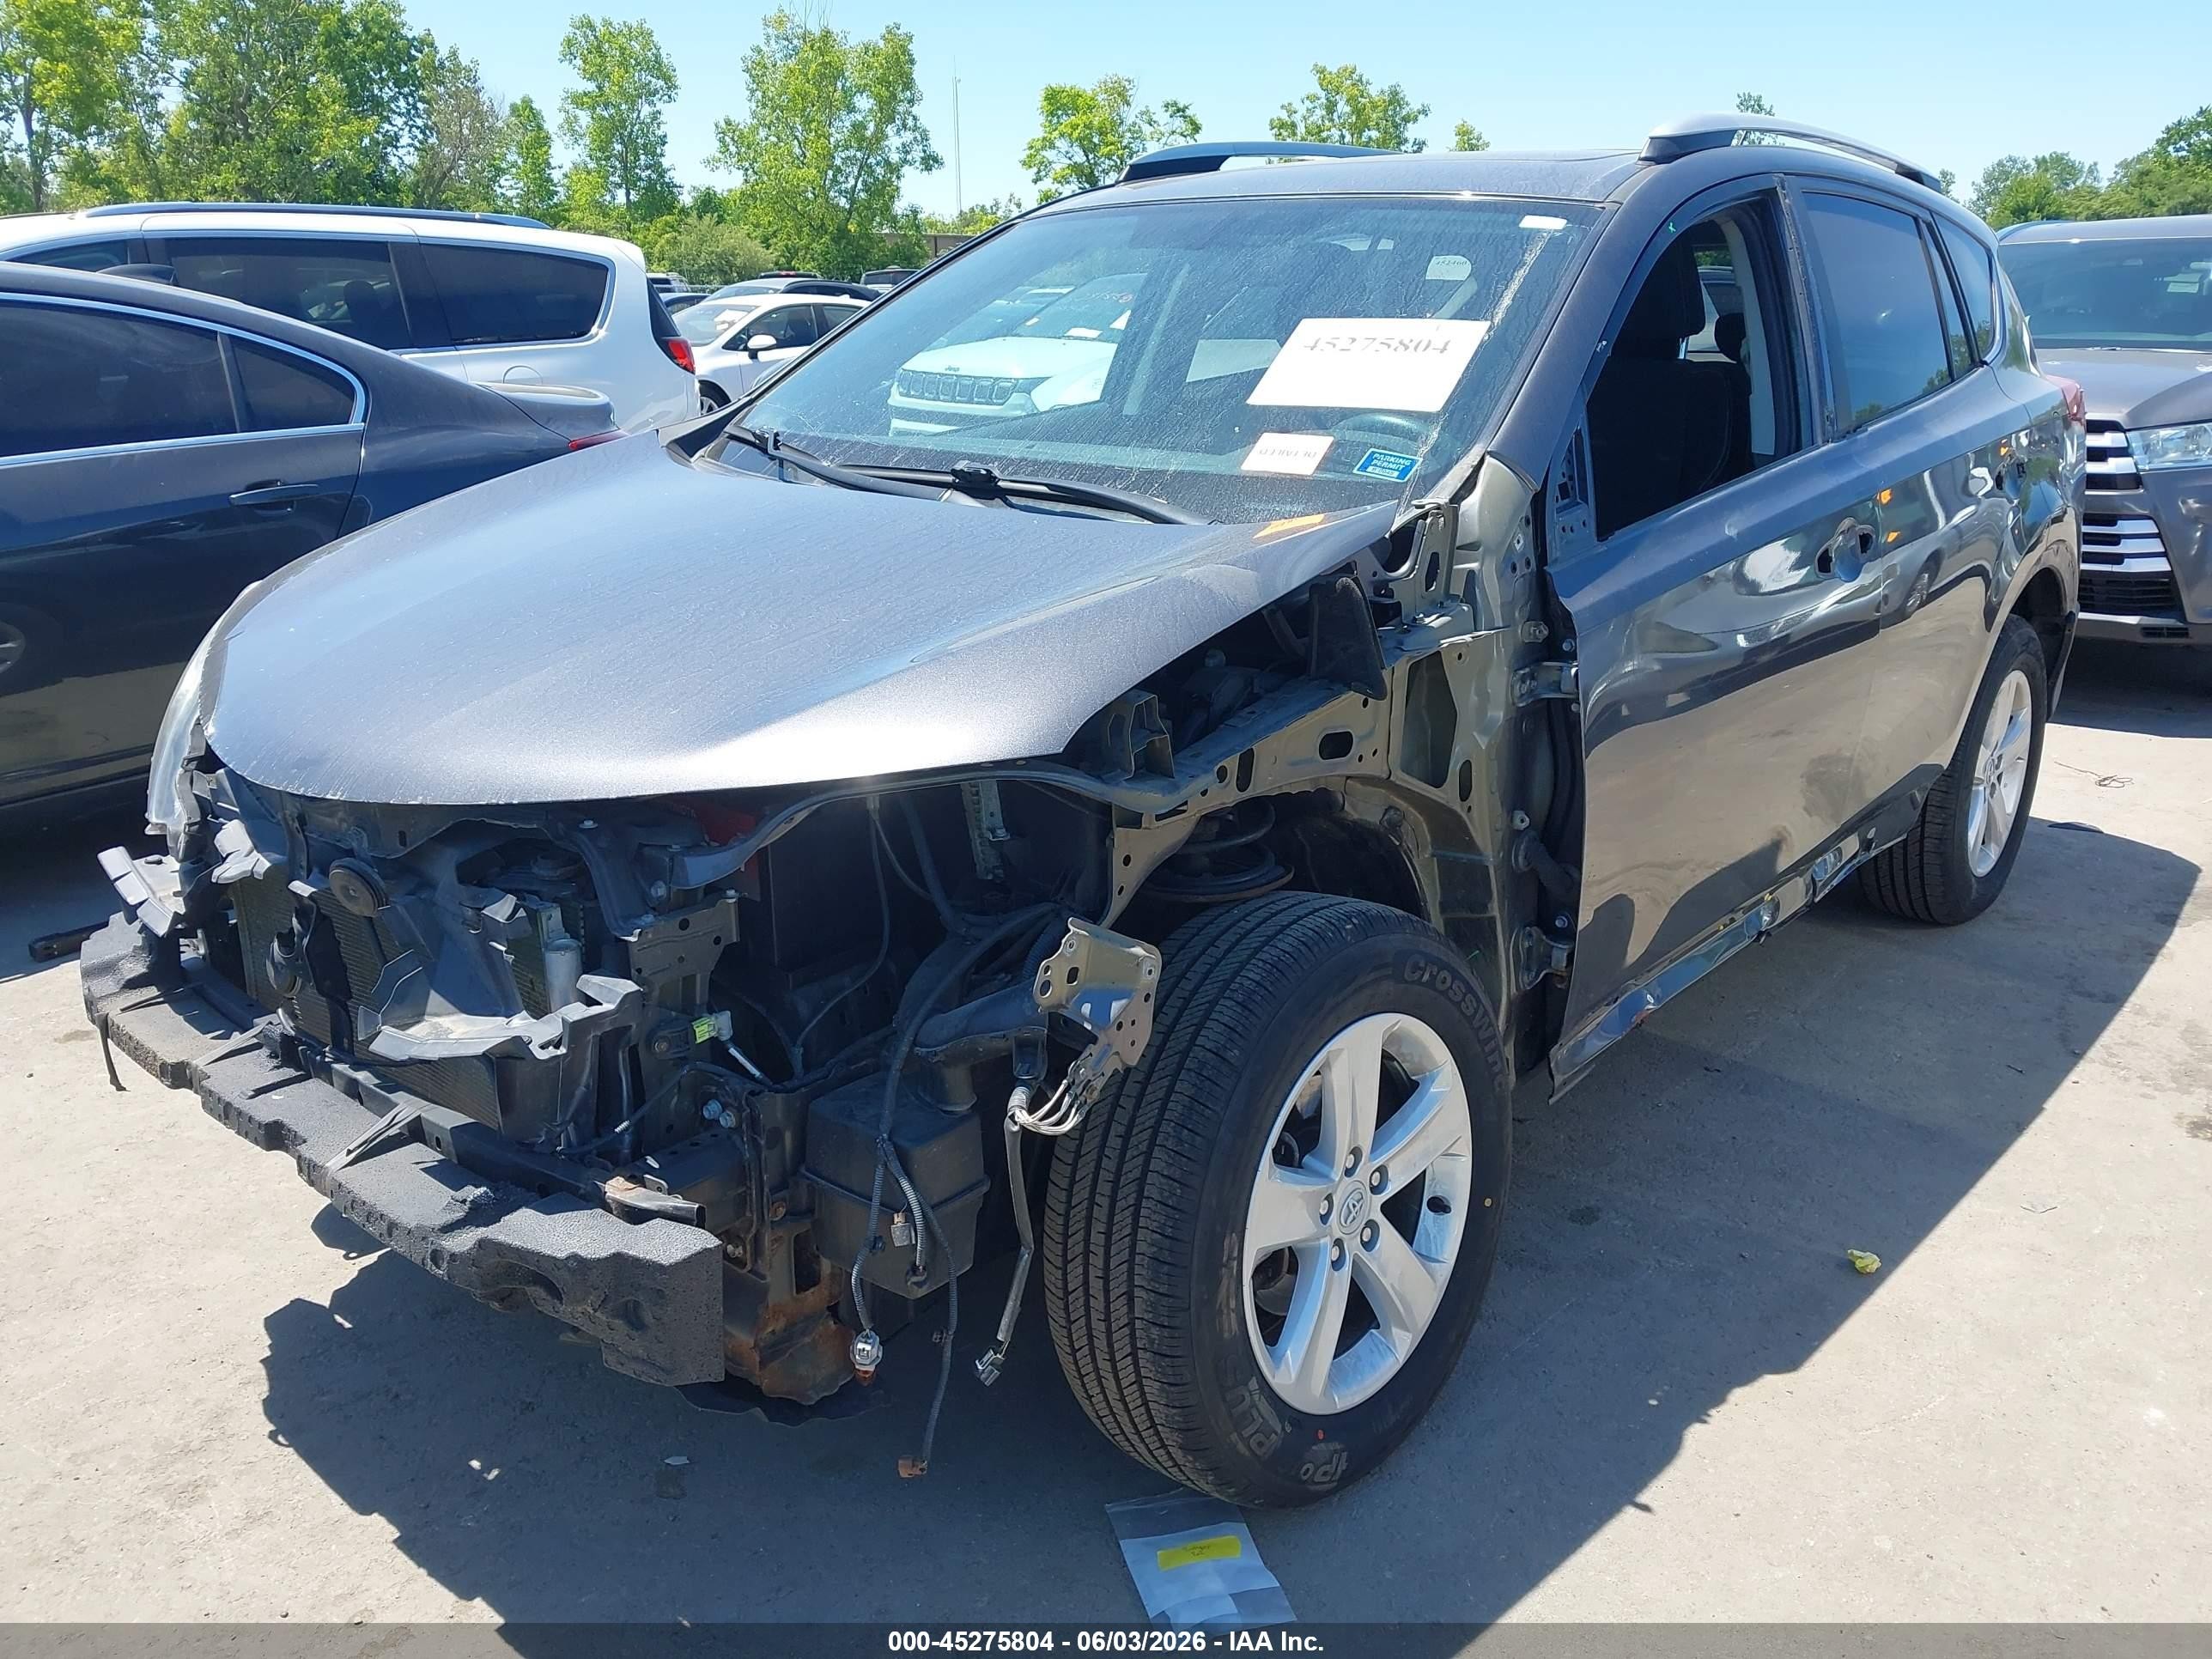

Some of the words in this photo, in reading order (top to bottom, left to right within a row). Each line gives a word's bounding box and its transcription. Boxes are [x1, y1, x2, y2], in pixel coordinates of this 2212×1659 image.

[1304, 337, 1451, 354] 45275804
[1371, 459, 1403, 471] PERMIT
[1373, 453, 1412, 465] PARKING
